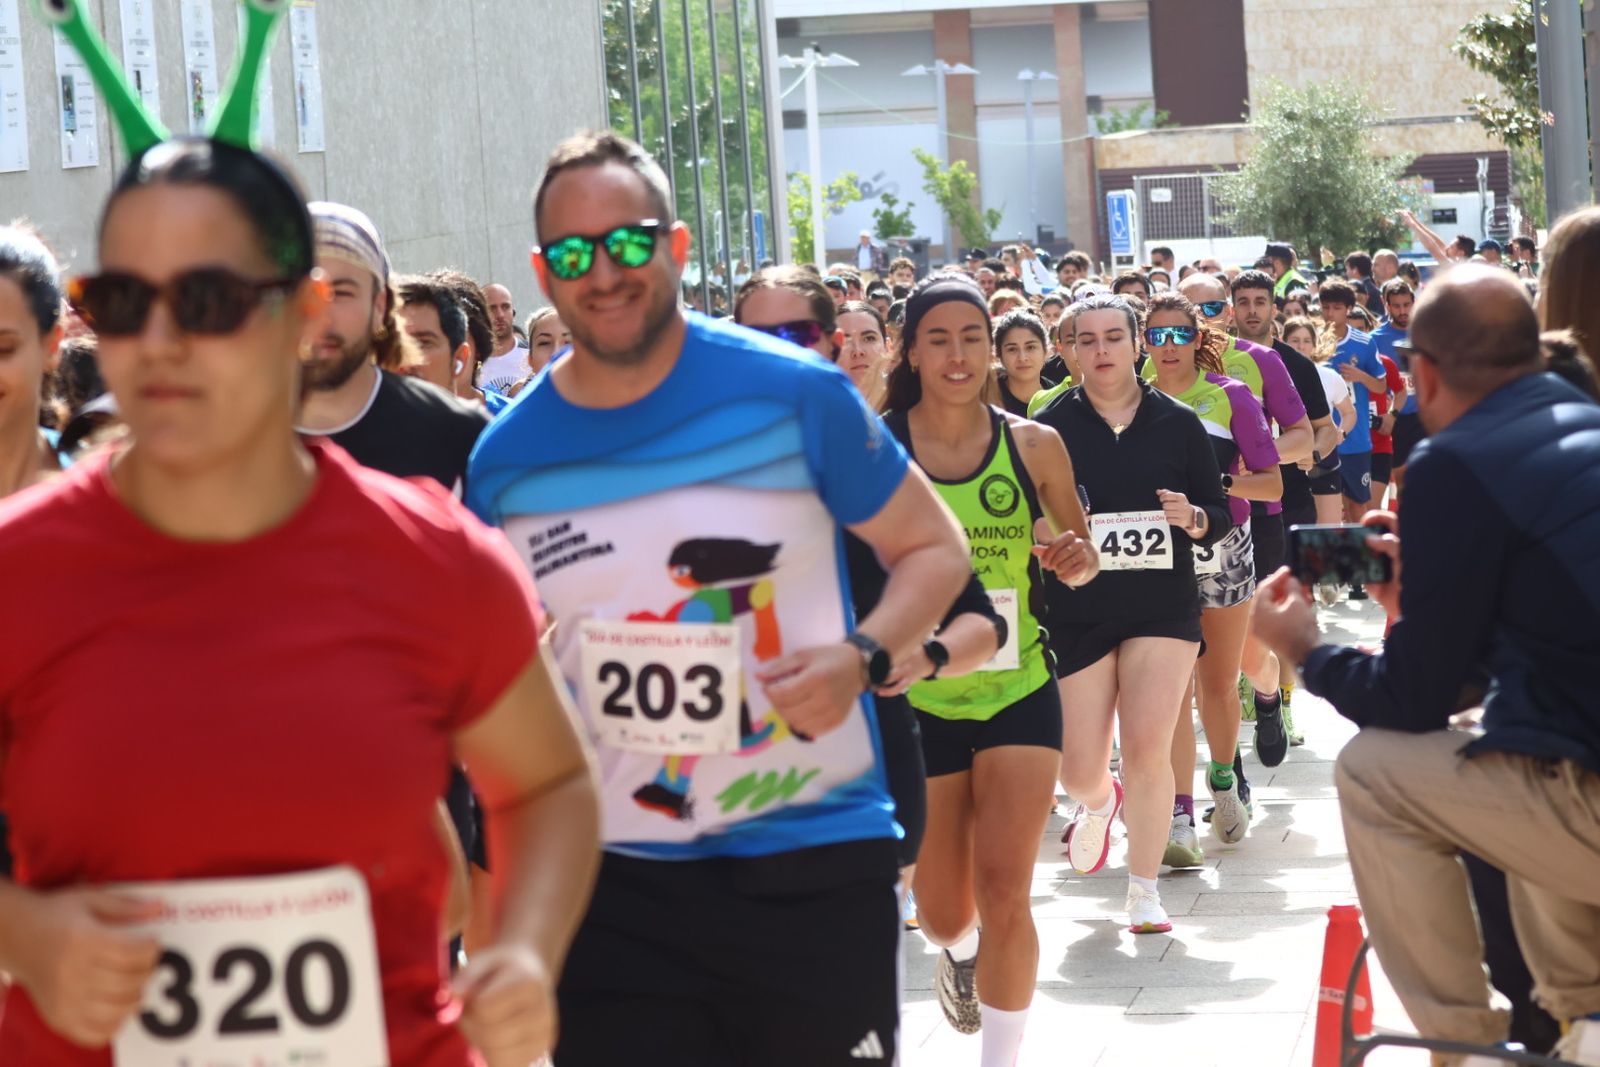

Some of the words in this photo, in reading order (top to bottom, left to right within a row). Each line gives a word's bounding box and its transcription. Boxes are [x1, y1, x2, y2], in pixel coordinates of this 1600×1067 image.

[964, 525, 1025, 540] AMINOS
[1100, 528, 1166, 557] 432
[597, 660, 724, 724] 203
[140, 939, 351, 1040] 320
